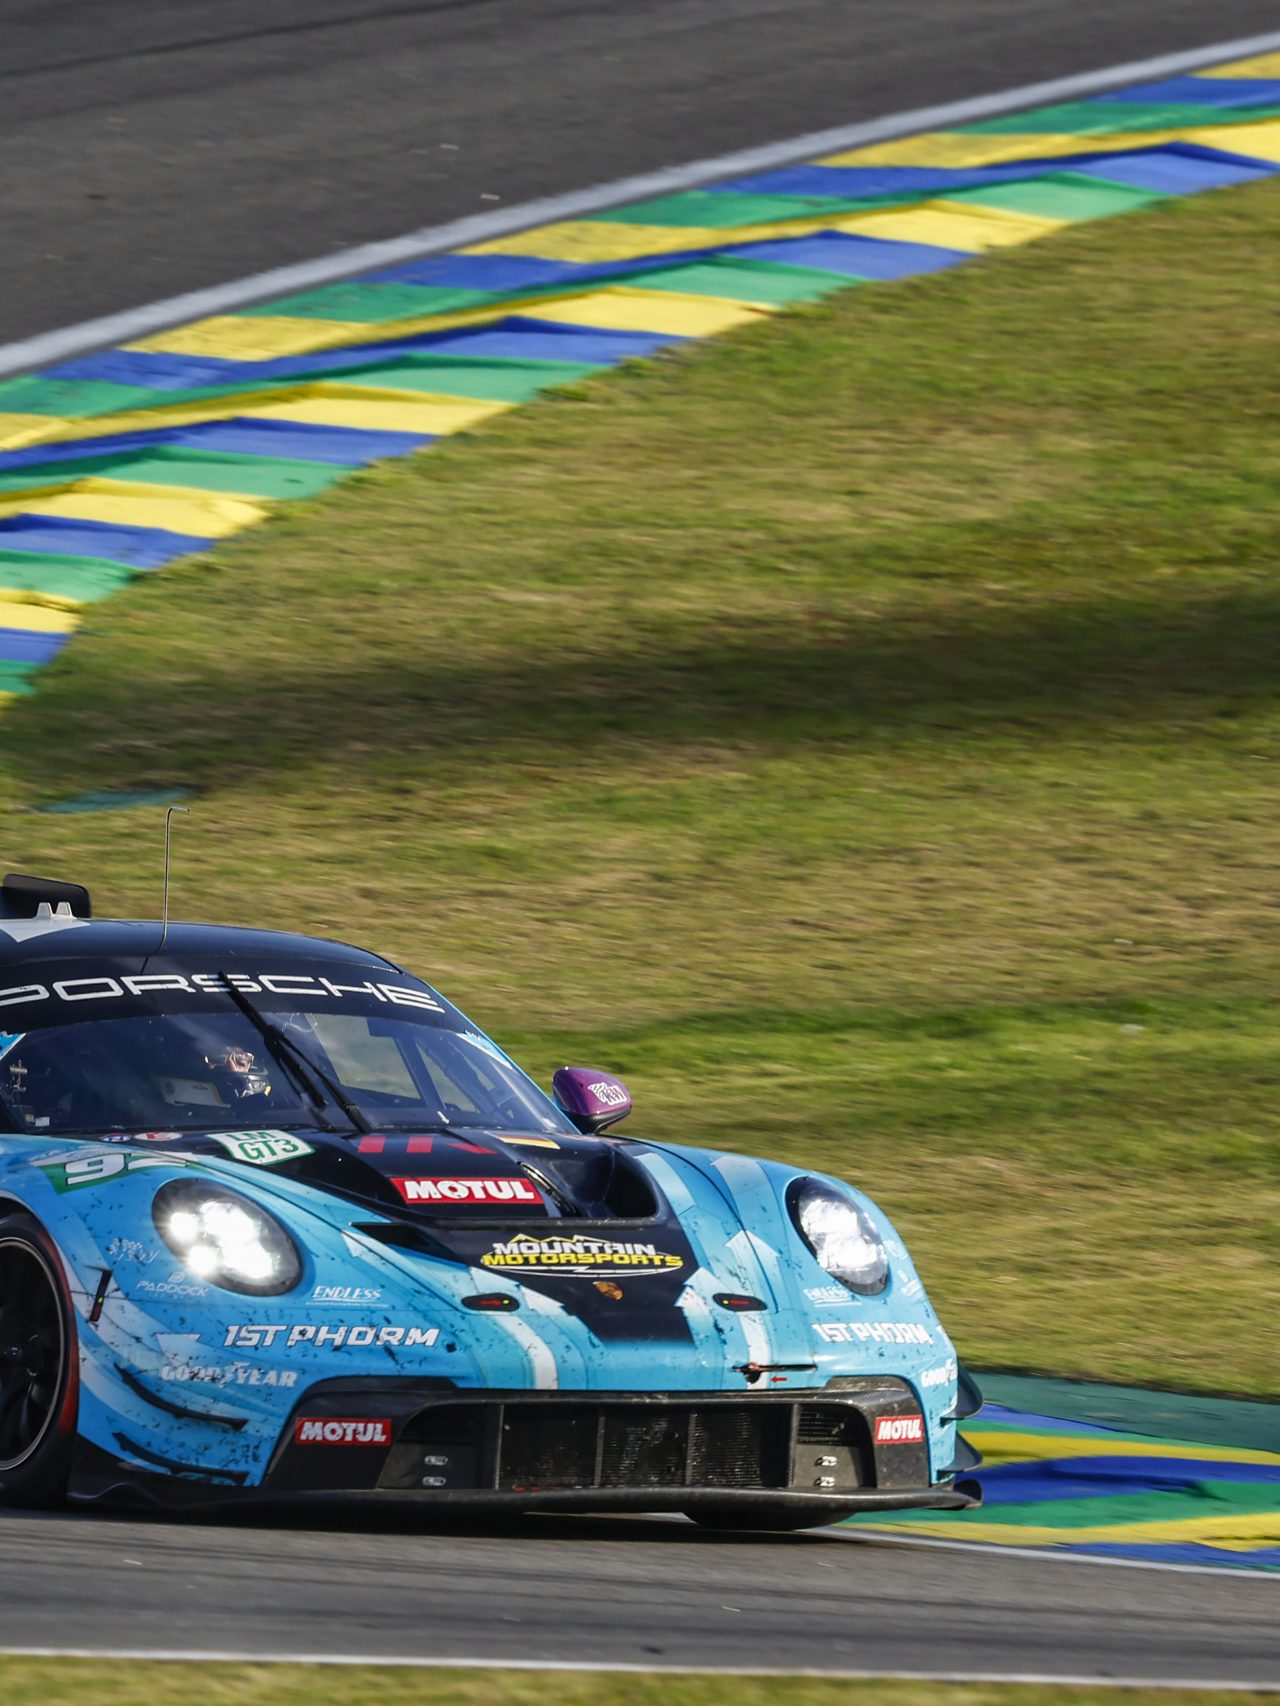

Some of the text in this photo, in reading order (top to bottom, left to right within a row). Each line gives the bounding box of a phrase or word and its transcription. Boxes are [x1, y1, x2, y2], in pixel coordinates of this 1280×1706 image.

[225, 1130, 275, 1141] LM
[235, 1138, 300, 1160] GT3
[405, 1179, 535, 1201] MOTUL
[492, 1241, 656, 1256] MOUNTAIN
[483, 1253, 684, 1268] MOTORSPORTS
[136, 1280, 208, 1297] PADDOCK
[312, 1285, 382, 1299] ENDLESS
[223, 1325, 441, 1348] 1ST PHORM
[811, 1322, 935, 1345] 1ST PHORM
[160, 1362, 297, 1388] GOODYEAR
[300, 1421, 387, 1442] MOTUL
[877, 1418, 922, 1441] MOTUL
